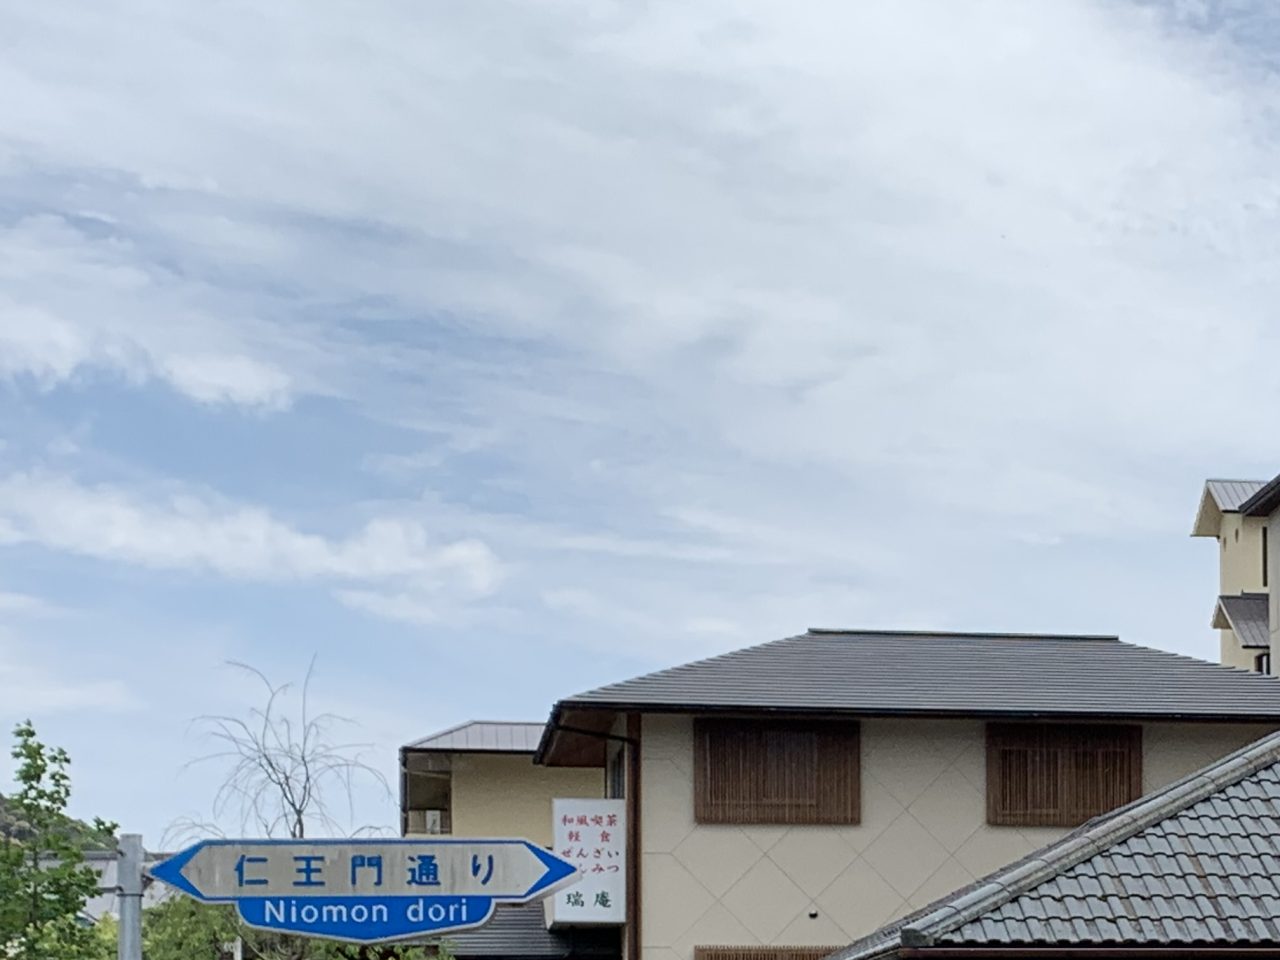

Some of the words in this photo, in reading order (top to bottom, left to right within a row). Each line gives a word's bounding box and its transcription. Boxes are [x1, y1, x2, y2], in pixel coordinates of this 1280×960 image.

[562, 814, 618, 827] 和風喫茶
[562, 847, 620, 859] ぜんざい
[234, 854, 494, 888] 仁王門通り
[566, 890, 612, 908] 瑞庵
[264, 899, 388, 923] Niomon
[406, 898, 467, 923] dori
